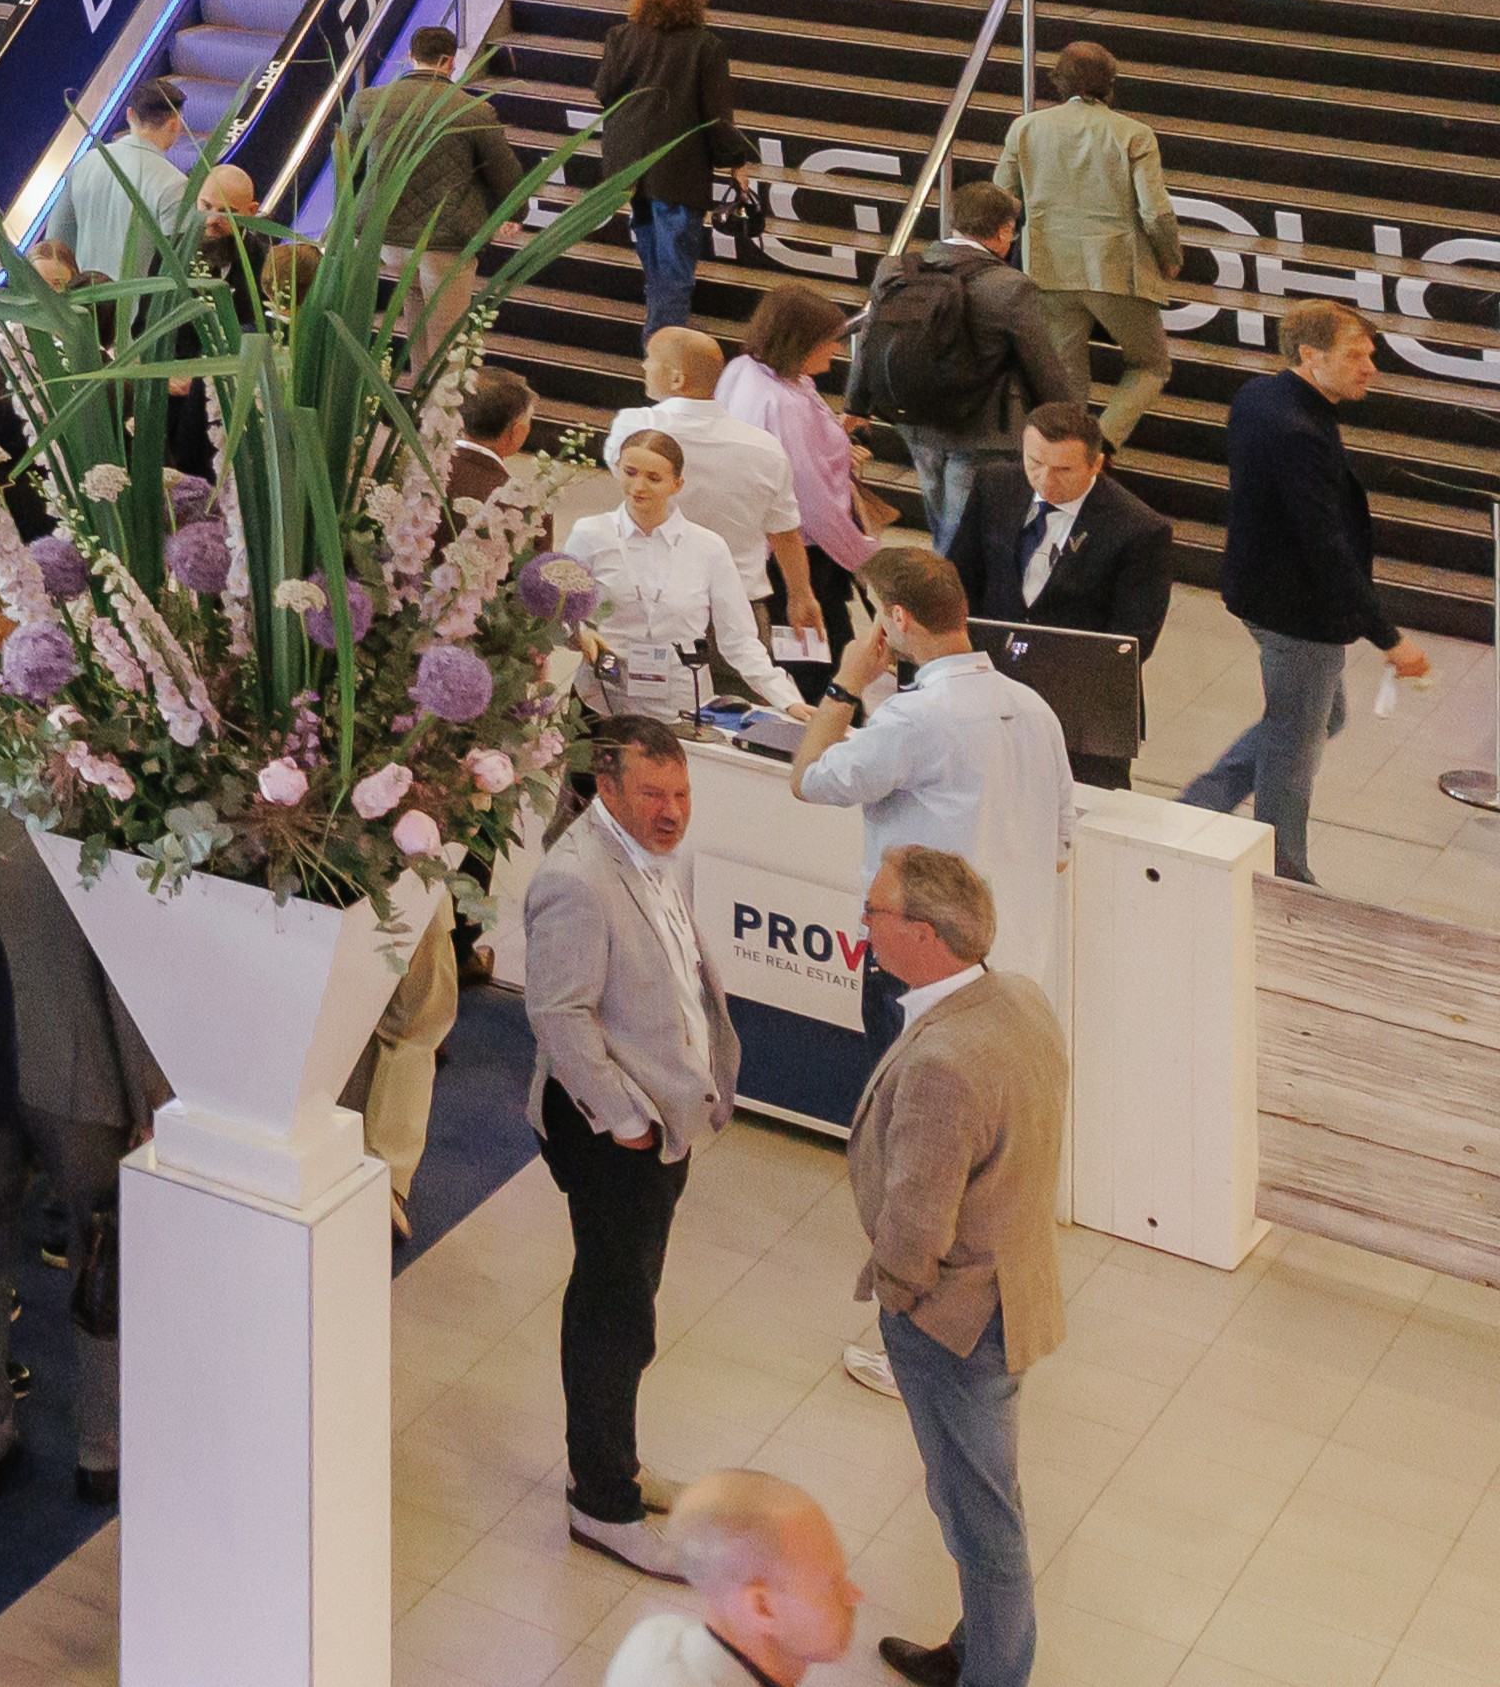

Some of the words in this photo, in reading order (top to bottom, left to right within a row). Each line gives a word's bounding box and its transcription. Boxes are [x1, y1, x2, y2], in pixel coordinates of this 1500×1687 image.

[733, 901, 869, 973] PROV
[734, 945, 761, 962] THE
[766, 954, 802, 976] REAL
[806, 966, 859, 991] ESTATE
